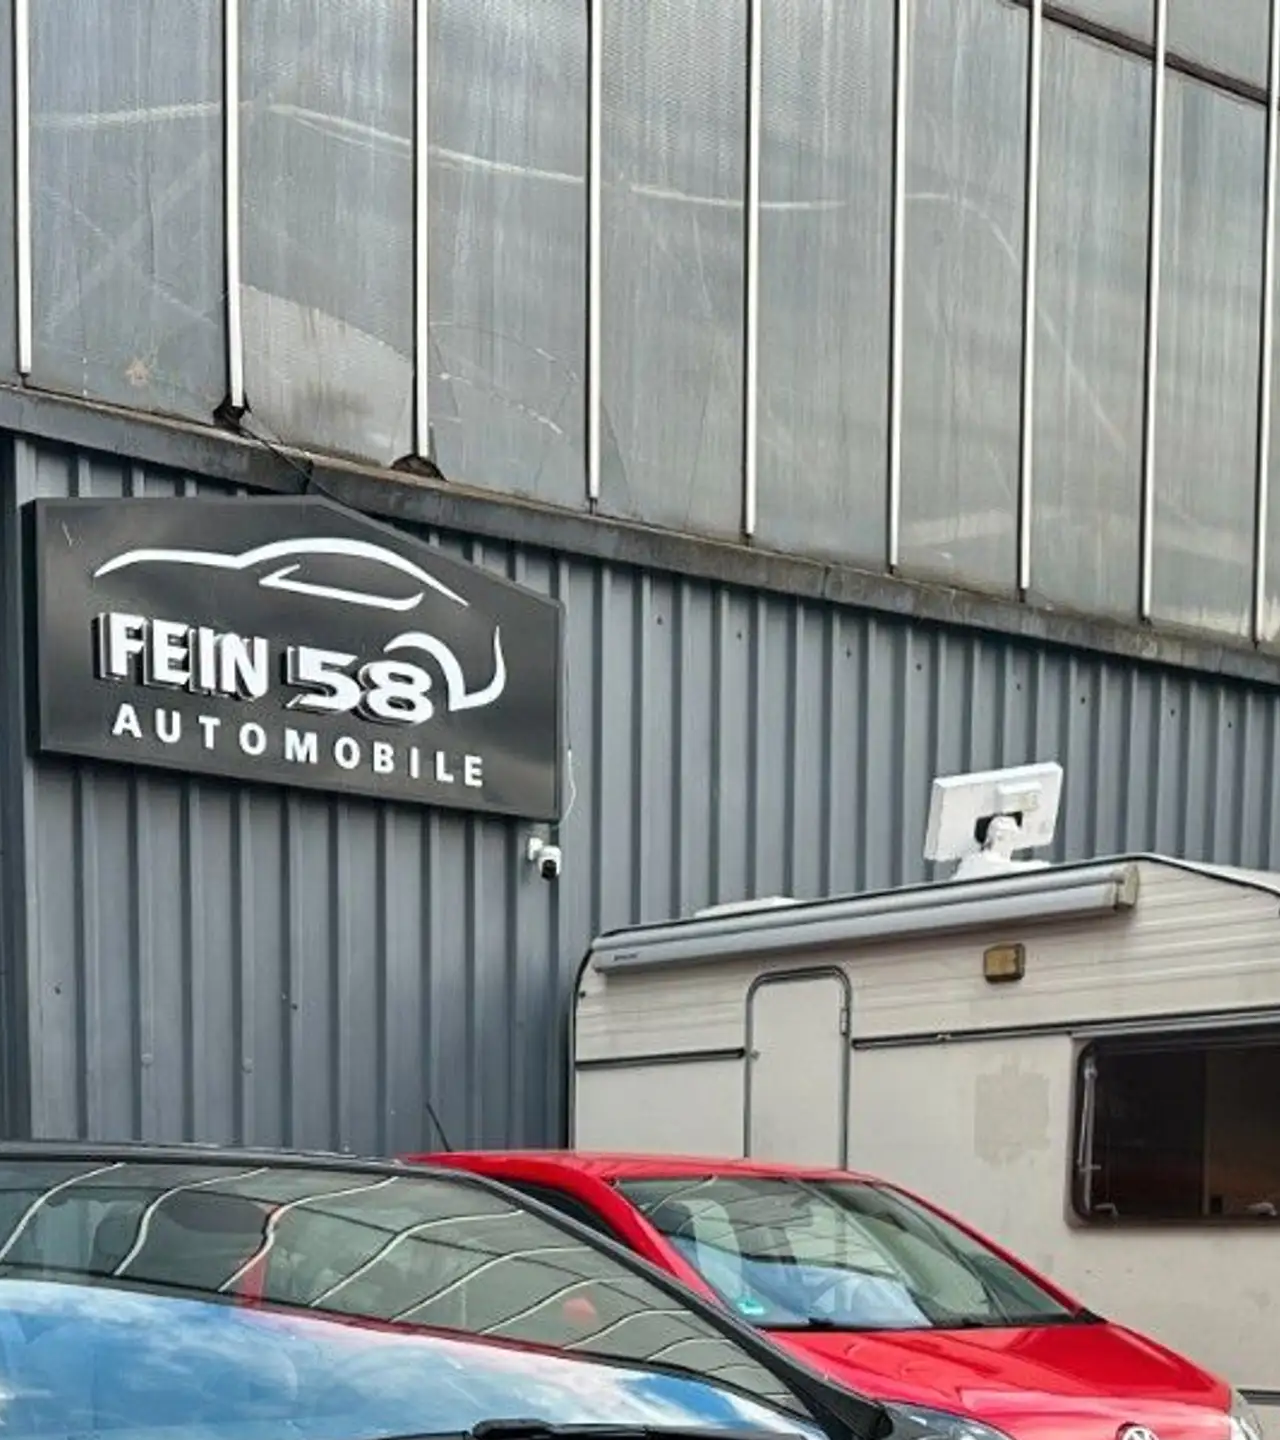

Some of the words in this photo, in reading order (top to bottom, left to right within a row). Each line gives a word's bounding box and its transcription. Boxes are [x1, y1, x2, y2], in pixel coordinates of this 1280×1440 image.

[98, 612, 269, 700] FEIN
[287, 645, 433, 726] 58
[112, 703, 484, 787] AUTOMOBILE
